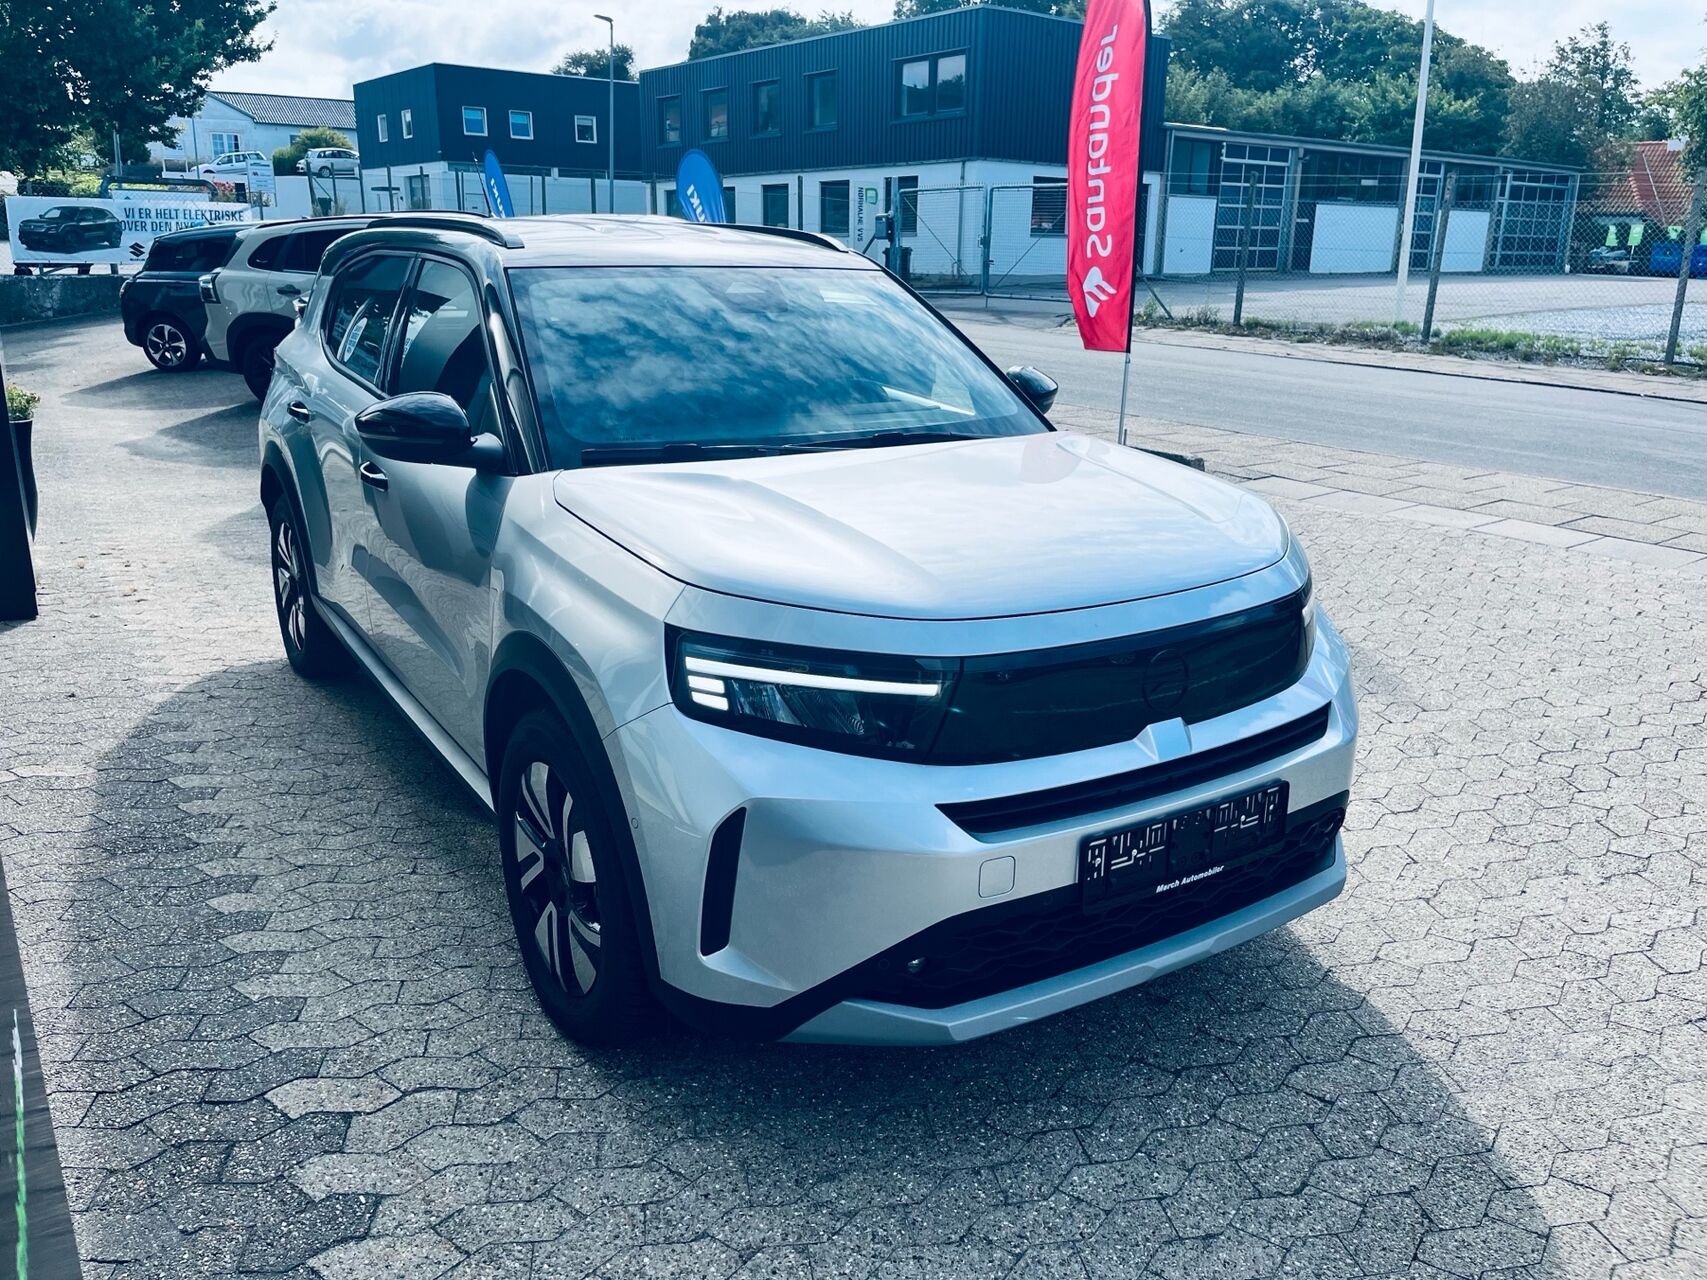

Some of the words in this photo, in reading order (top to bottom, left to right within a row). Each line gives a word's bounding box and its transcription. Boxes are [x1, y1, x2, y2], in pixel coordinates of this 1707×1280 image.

[124, 207, 135, 219] VI
[138, 207, 152, 219] ER
[155, 208, 180, 220] HELT
[183, 209, 244, 222] ELEKTRISKE
[121, 220, 148, 232] OVER
[151, 221, 172, 232] DEN
[1180, 865, 1225, 886] Automobiler
